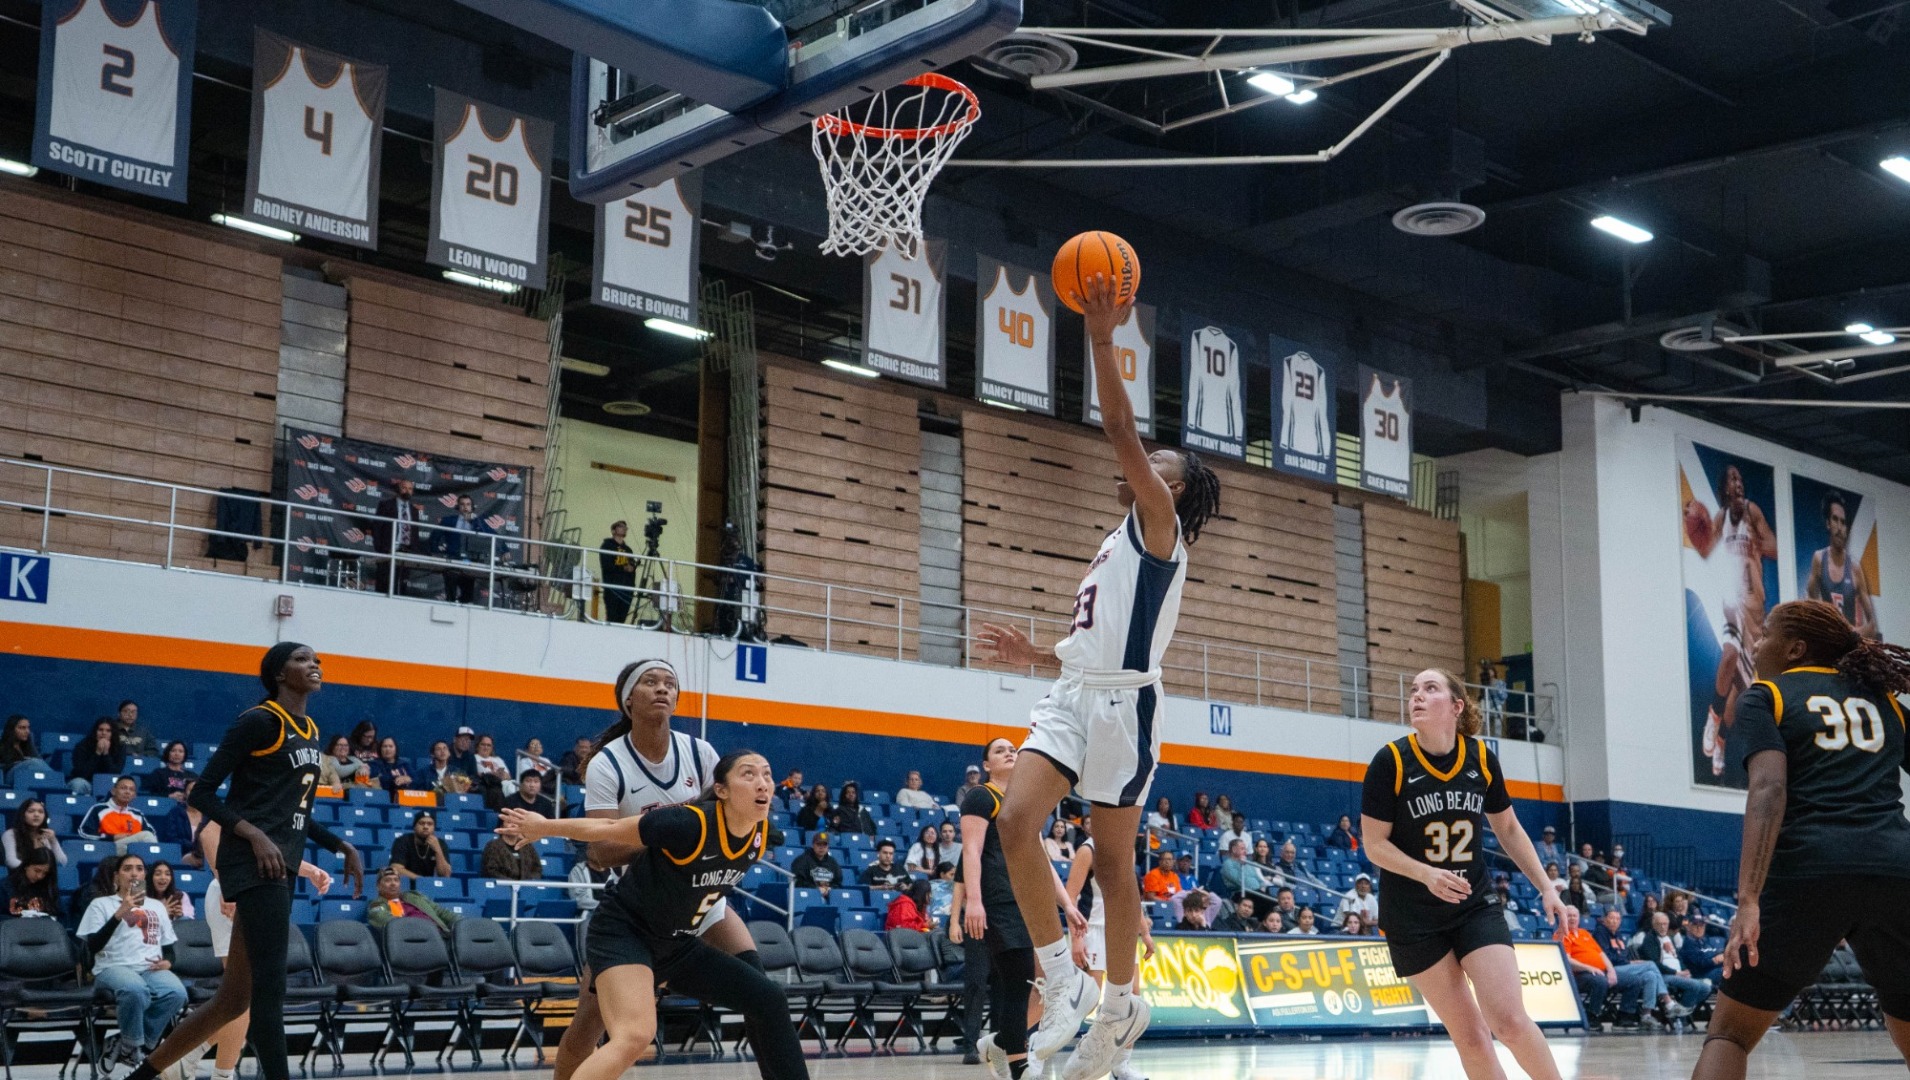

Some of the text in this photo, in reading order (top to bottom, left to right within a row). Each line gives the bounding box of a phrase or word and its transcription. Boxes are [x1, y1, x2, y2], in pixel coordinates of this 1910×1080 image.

[101, 43, 134, 97] 2
[304, 105, 333, 156] 4
[49, 142, 172, 188] SCOTT CUTLEY
[466, 154, 518, 206] 20
[253, 198, 369, 242] RODNEY ANDERSON
[625, 200, 672, 248] 25
[449, 248, 527, 280] LEON WOOD
[602, 286, 688, 321] BRUCE BOWEN
[889, 272, 921, 315] 31
[999, 306, 1034, 348] 40
[868, 352, 940, 381] CEDRIC CEBALLOS
[1204, 346, 1225, 377] 10
[982, 382, 1049, 409] NANCY DUNKLE
[1295, 370, 1315, 401] 23
[1374, 408, 1399, 442] 30
[9, 557, 39, 599] K
[745, 647, 758, 680] L
[1213, 706, 1229, 733] M
[1805, 695, 1885, 753] 30
[289, 748, 310, 769] LONG
[299, 773, 314, 809] 2
[1407, 791, 1483, 819] LONG BEACH
[1424, 819, 1473, 863] 32
[692, 870, 723, 887] LONG
[691, 892, 720, 926] 5
[1250, 948, 1356, 992] C-S-U-F
[1519, 971, 1563, 985] SHOP
[1370, 986, 1414, 1008] FIGHT!
